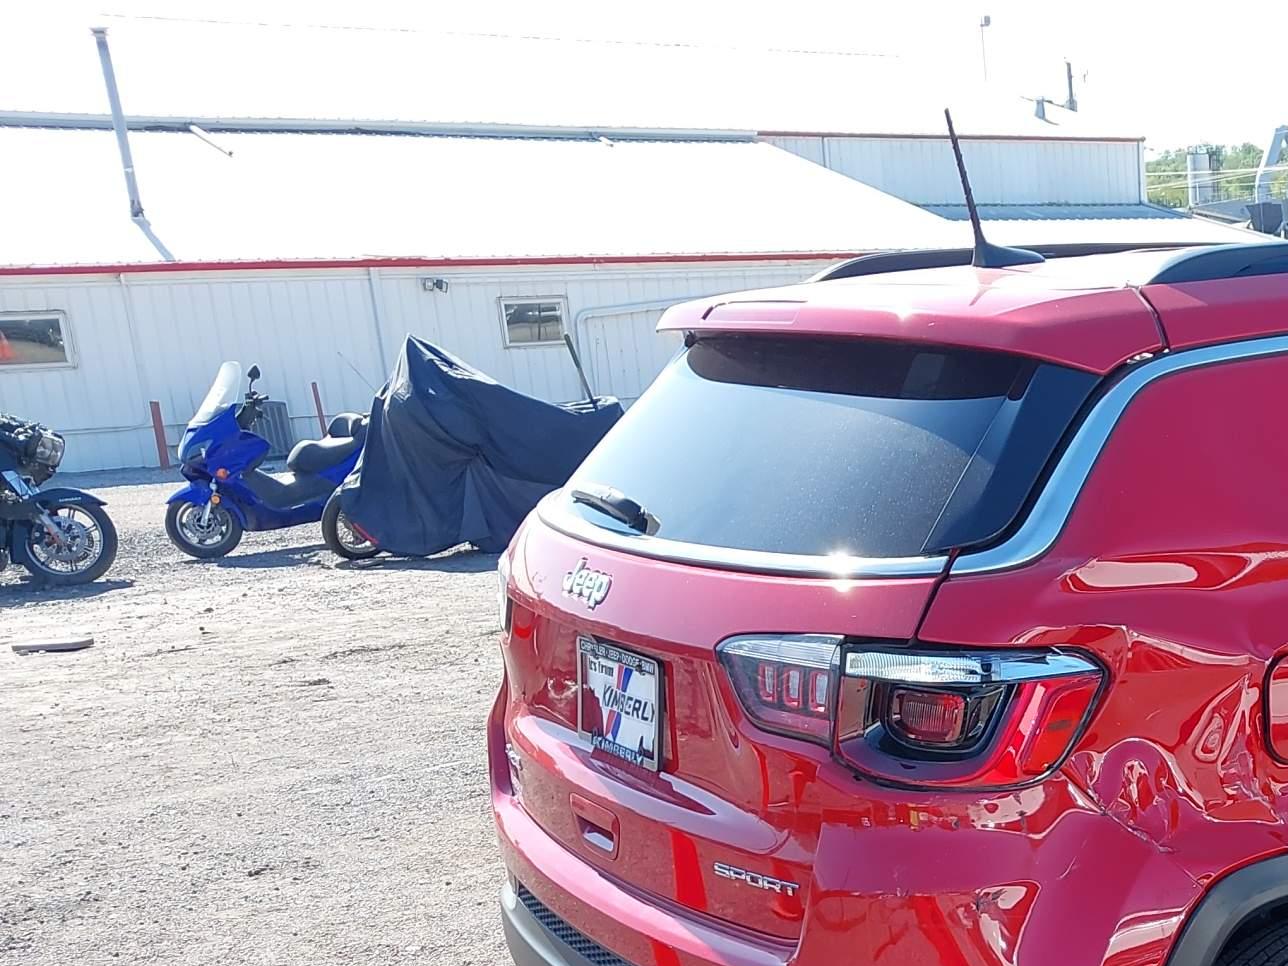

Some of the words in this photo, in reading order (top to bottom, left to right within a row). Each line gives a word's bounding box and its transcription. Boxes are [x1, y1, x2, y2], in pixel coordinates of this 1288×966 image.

[562, 556, 613, 611] Jeep
[602, 684, 656, 724] KIMBERLY
[592, 735, 644, 765] KIMBERLY
[713, 862, 800, 897] SPORT
